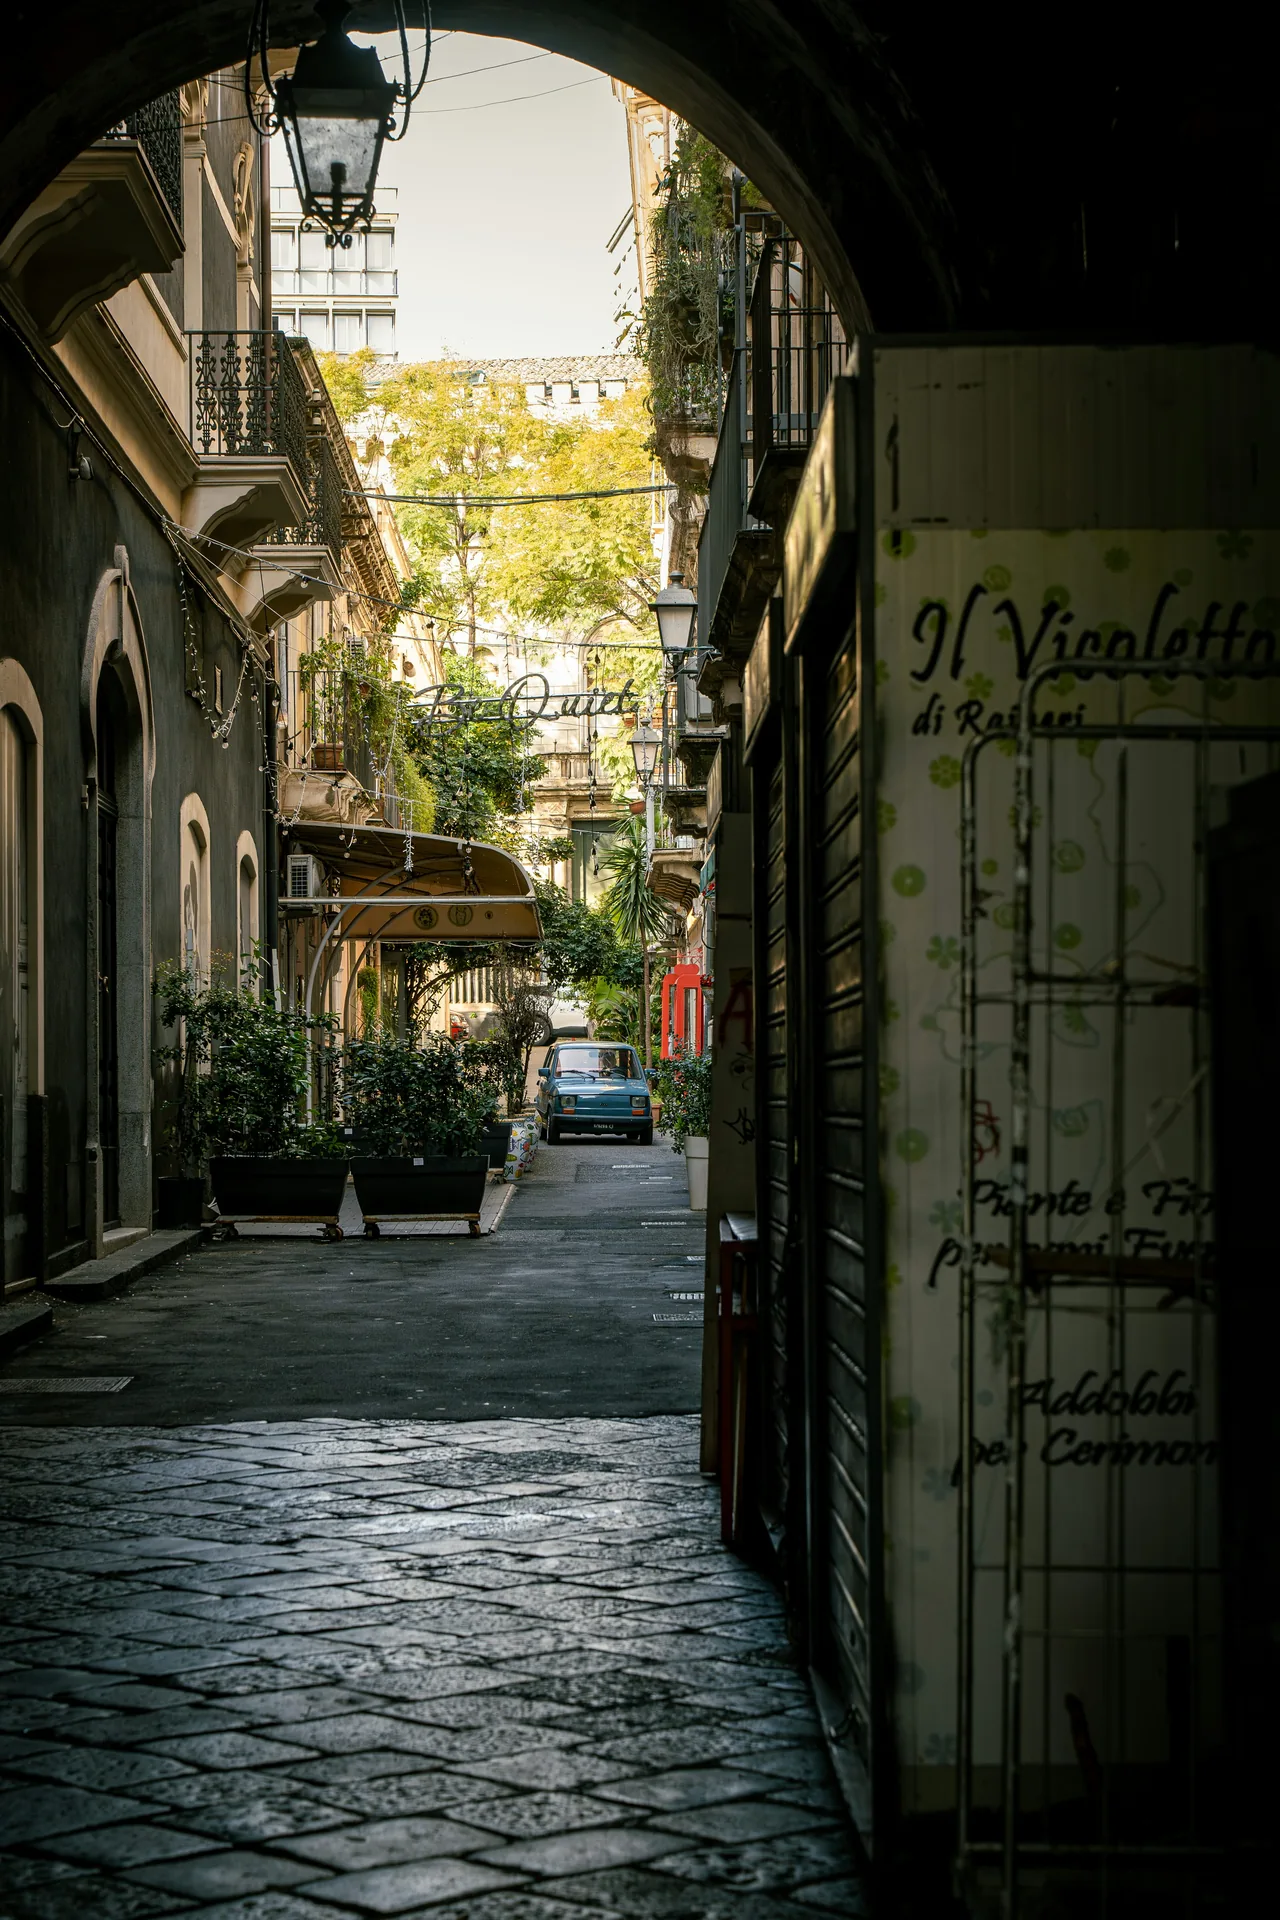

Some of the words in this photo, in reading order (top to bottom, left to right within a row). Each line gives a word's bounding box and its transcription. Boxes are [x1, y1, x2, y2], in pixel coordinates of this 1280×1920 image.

[911, 584, 986, 681] Il
[994, 582, 1276, 681] Vicoletto
[498, 673, 640, 731] Quiet
[912, 692, 945, 735] di
